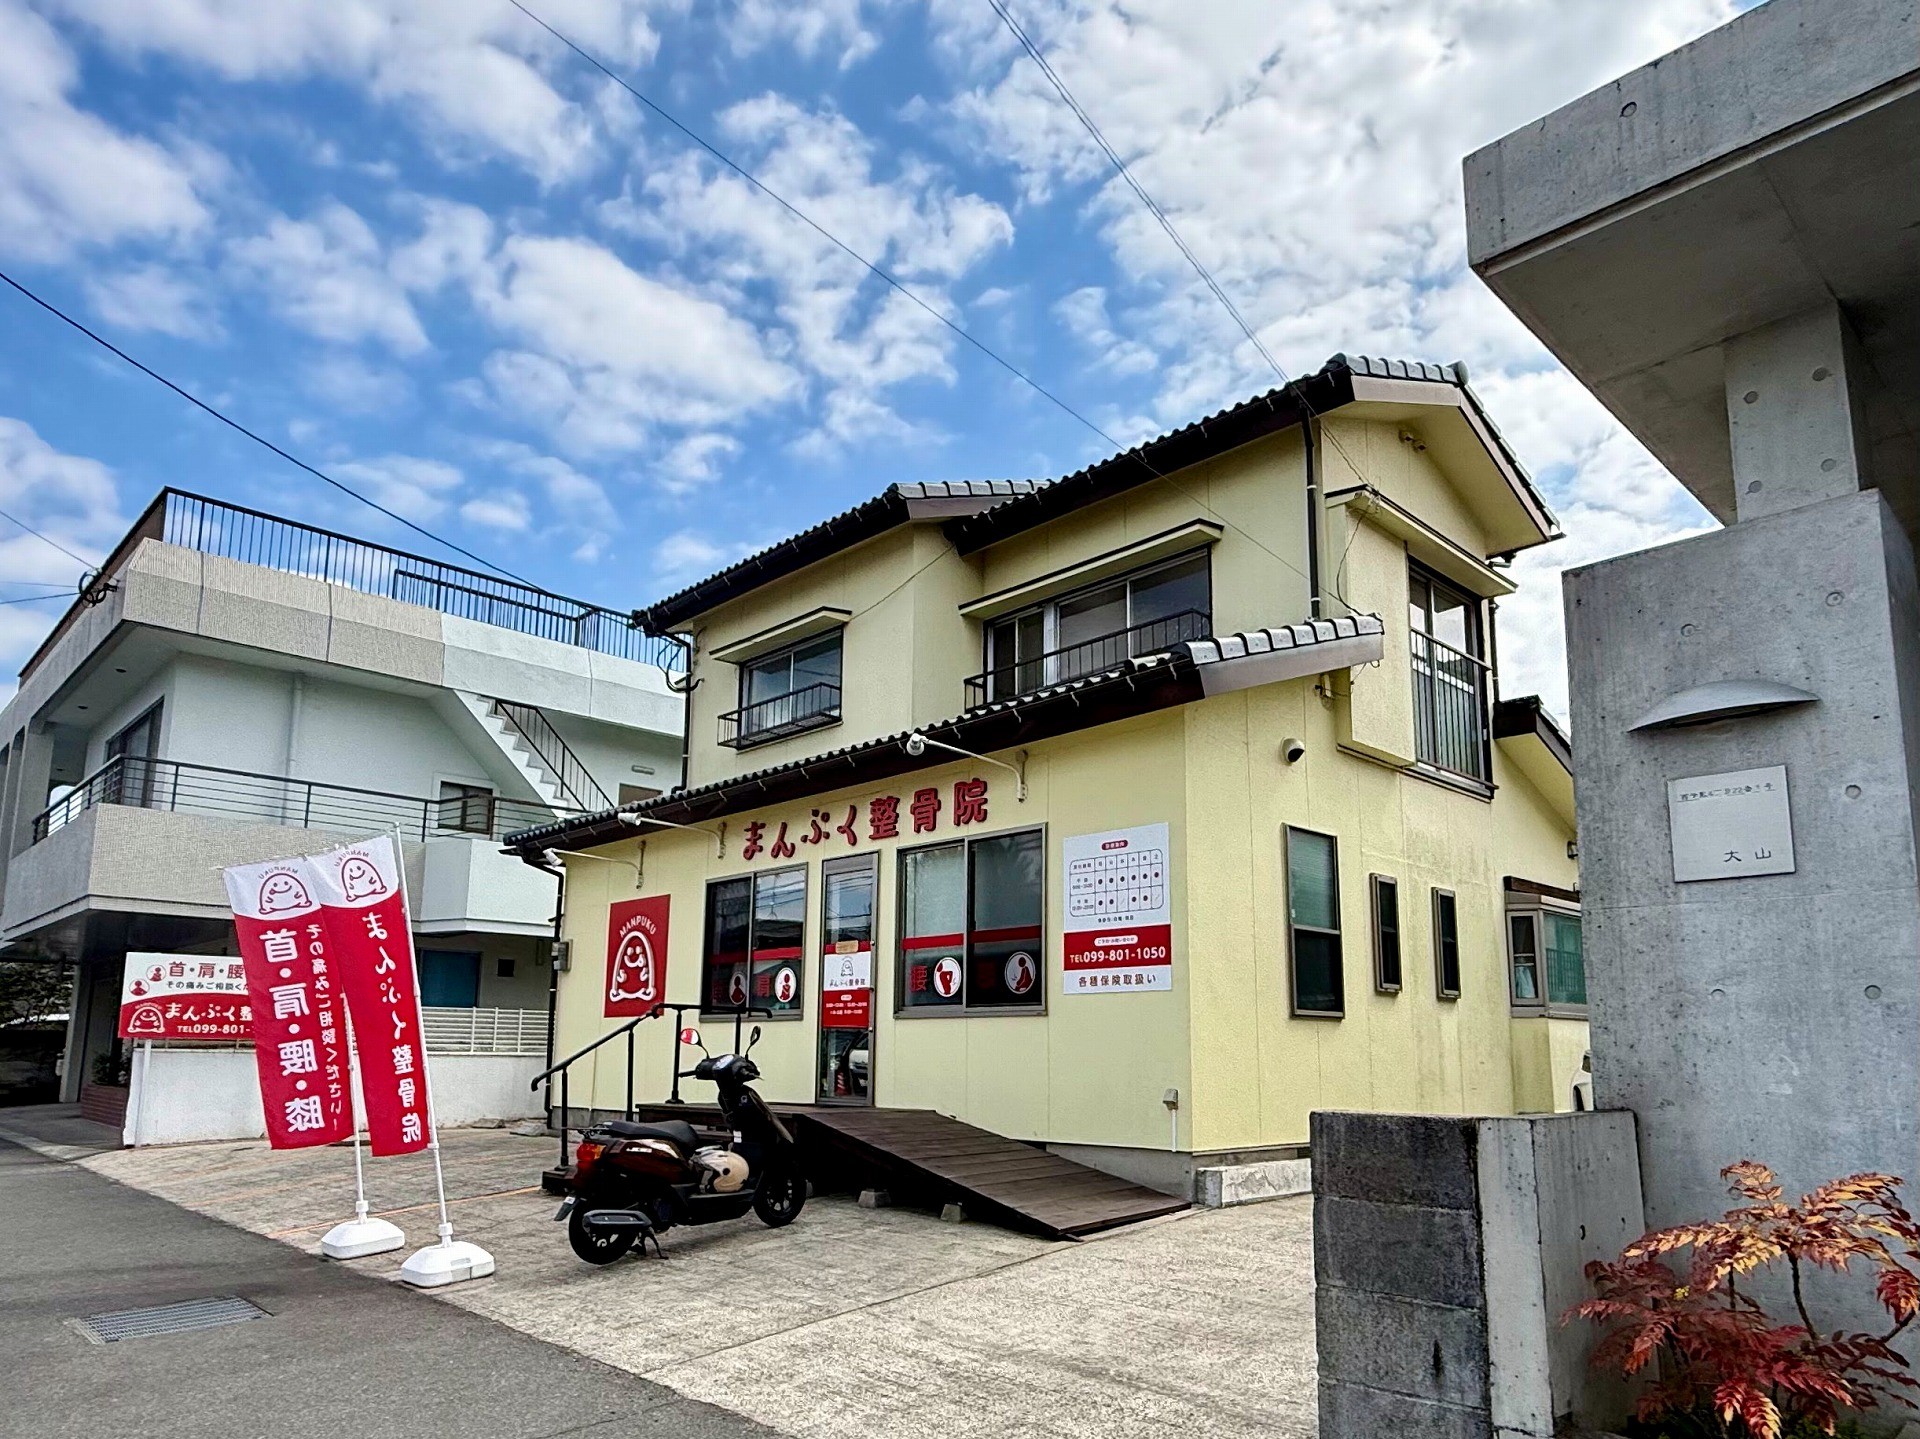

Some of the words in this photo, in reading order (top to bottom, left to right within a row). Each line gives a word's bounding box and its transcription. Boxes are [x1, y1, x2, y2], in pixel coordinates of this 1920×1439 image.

[743, 778, 988, 860] まんぷく整骨院
[1723, 847, 1772, 863] 大山
[619, 915, 657, 938] MANPUKU
[1070, 946, 1166, 964] TEL099-801-1050
[1079, 973, 1156, 988] 各種保険取扱い
